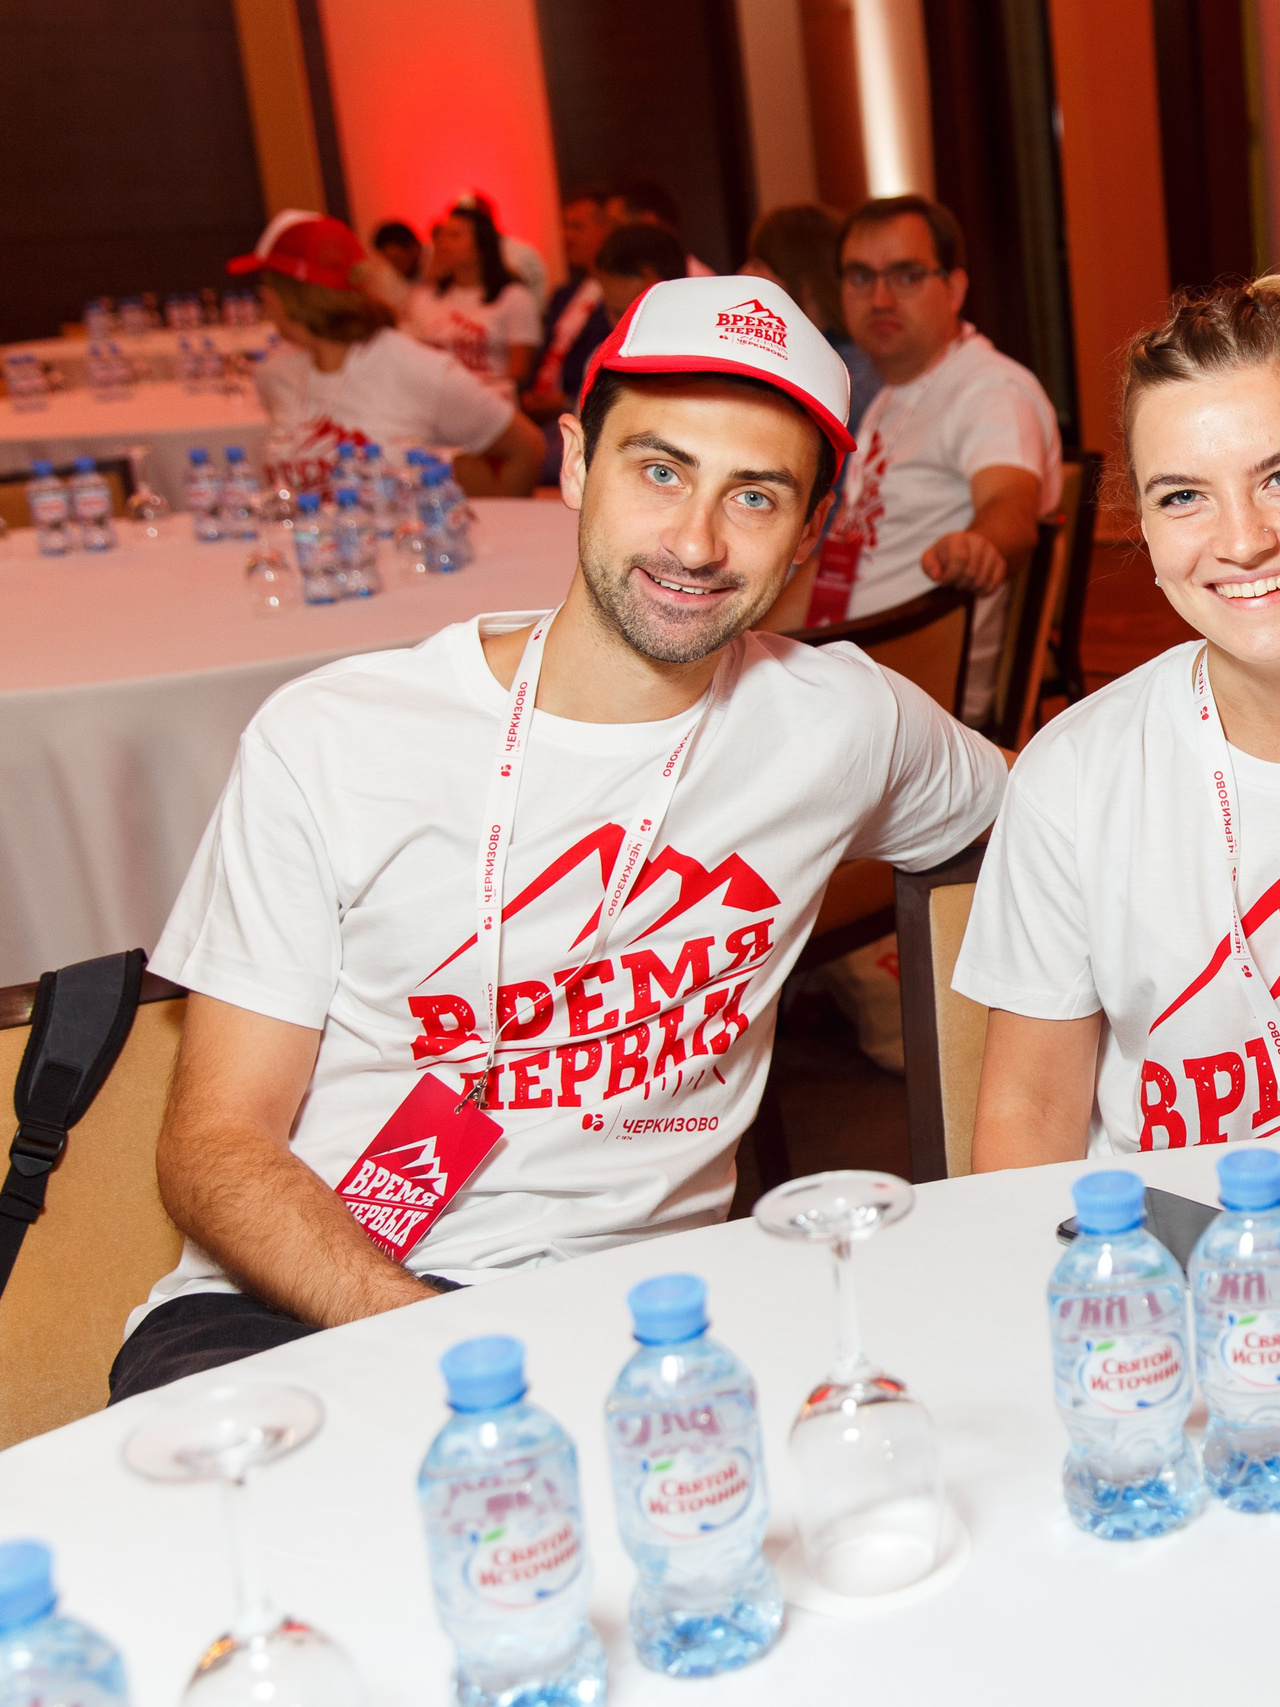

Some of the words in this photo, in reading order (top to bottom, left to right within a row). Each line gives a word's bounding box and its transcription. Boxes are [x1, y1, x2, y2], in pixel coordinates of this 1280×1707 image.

[716, 313, 787, 332] ВРЕМЯ
[724, 327, 788, 349] ПЕРВЫХ
[736, 338, 789, 361] ЧЕРКИЗОВО
[505, 681, 528, 752] ЧЕРКИЗОВО
[1214, 770, 1234, 854] ЧЕРКИЗОВО
[484, 824, 501, 903] ЧЕРКИЗОВО
[608, 842, 642, 917] ЧЕРКИЗОВО
[623, 1116, 719, 1134] ЧЕРКИЗОВО
[342, 1159, 440, 1207] ВРЕМЯ
